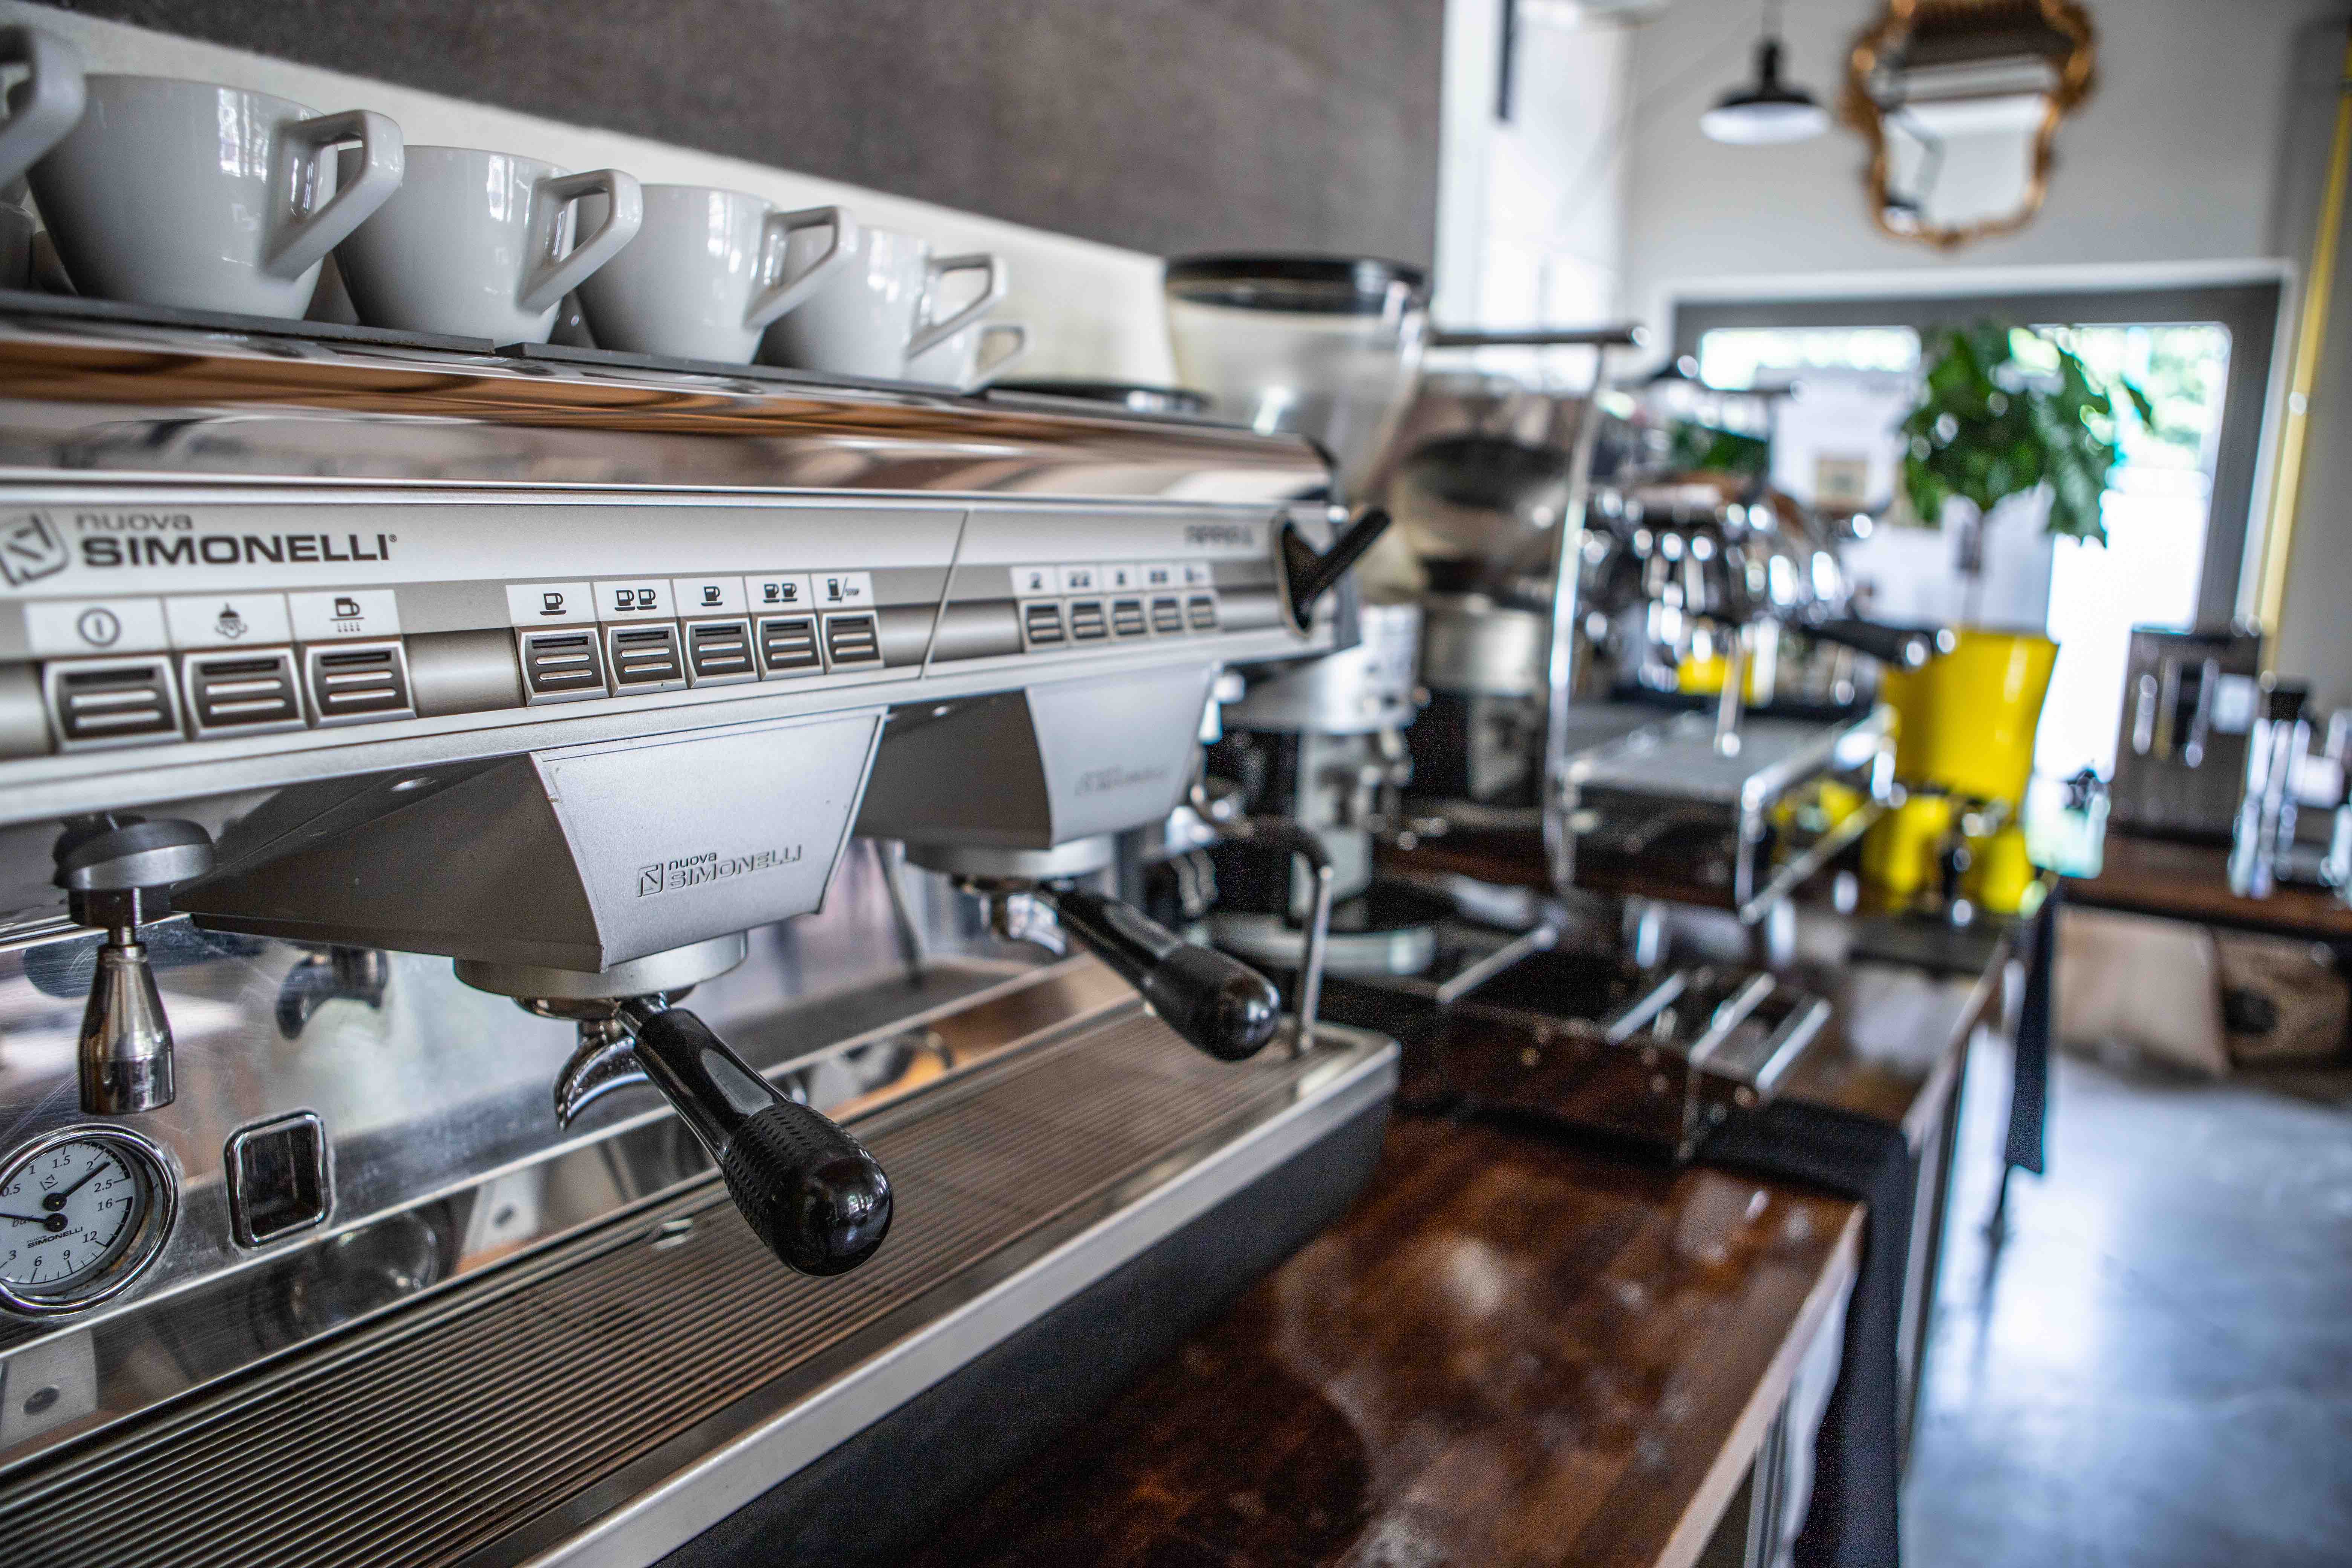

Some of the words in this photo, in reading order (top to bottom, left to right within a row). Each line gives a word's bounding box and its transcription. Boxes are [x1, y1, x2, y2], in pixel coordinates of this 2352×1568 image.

[77, 514, 194, 530] nuova
[669, 852, 717, 870] nuova
[669, 844, 802, 890] SIMONELLI
[52, 1155, 71, 1169] 1.5
[86, 1161, 93, 1171] 2
[29, 1165, 36, 1175] 1
[1, 1183, 21, 1197] 0.5
[94, 1179, 113, 1193] 2.5
[98, 1197, 113, 1211] 16
[27, 1226, 83, 1248] SIMONELLI
[82, 1230, 97, 1243] 12
[9, 1250, 17, 1261] 3
[34, 1256, 42, 1266] 6
[63, 1250, 71, 1260] 9
